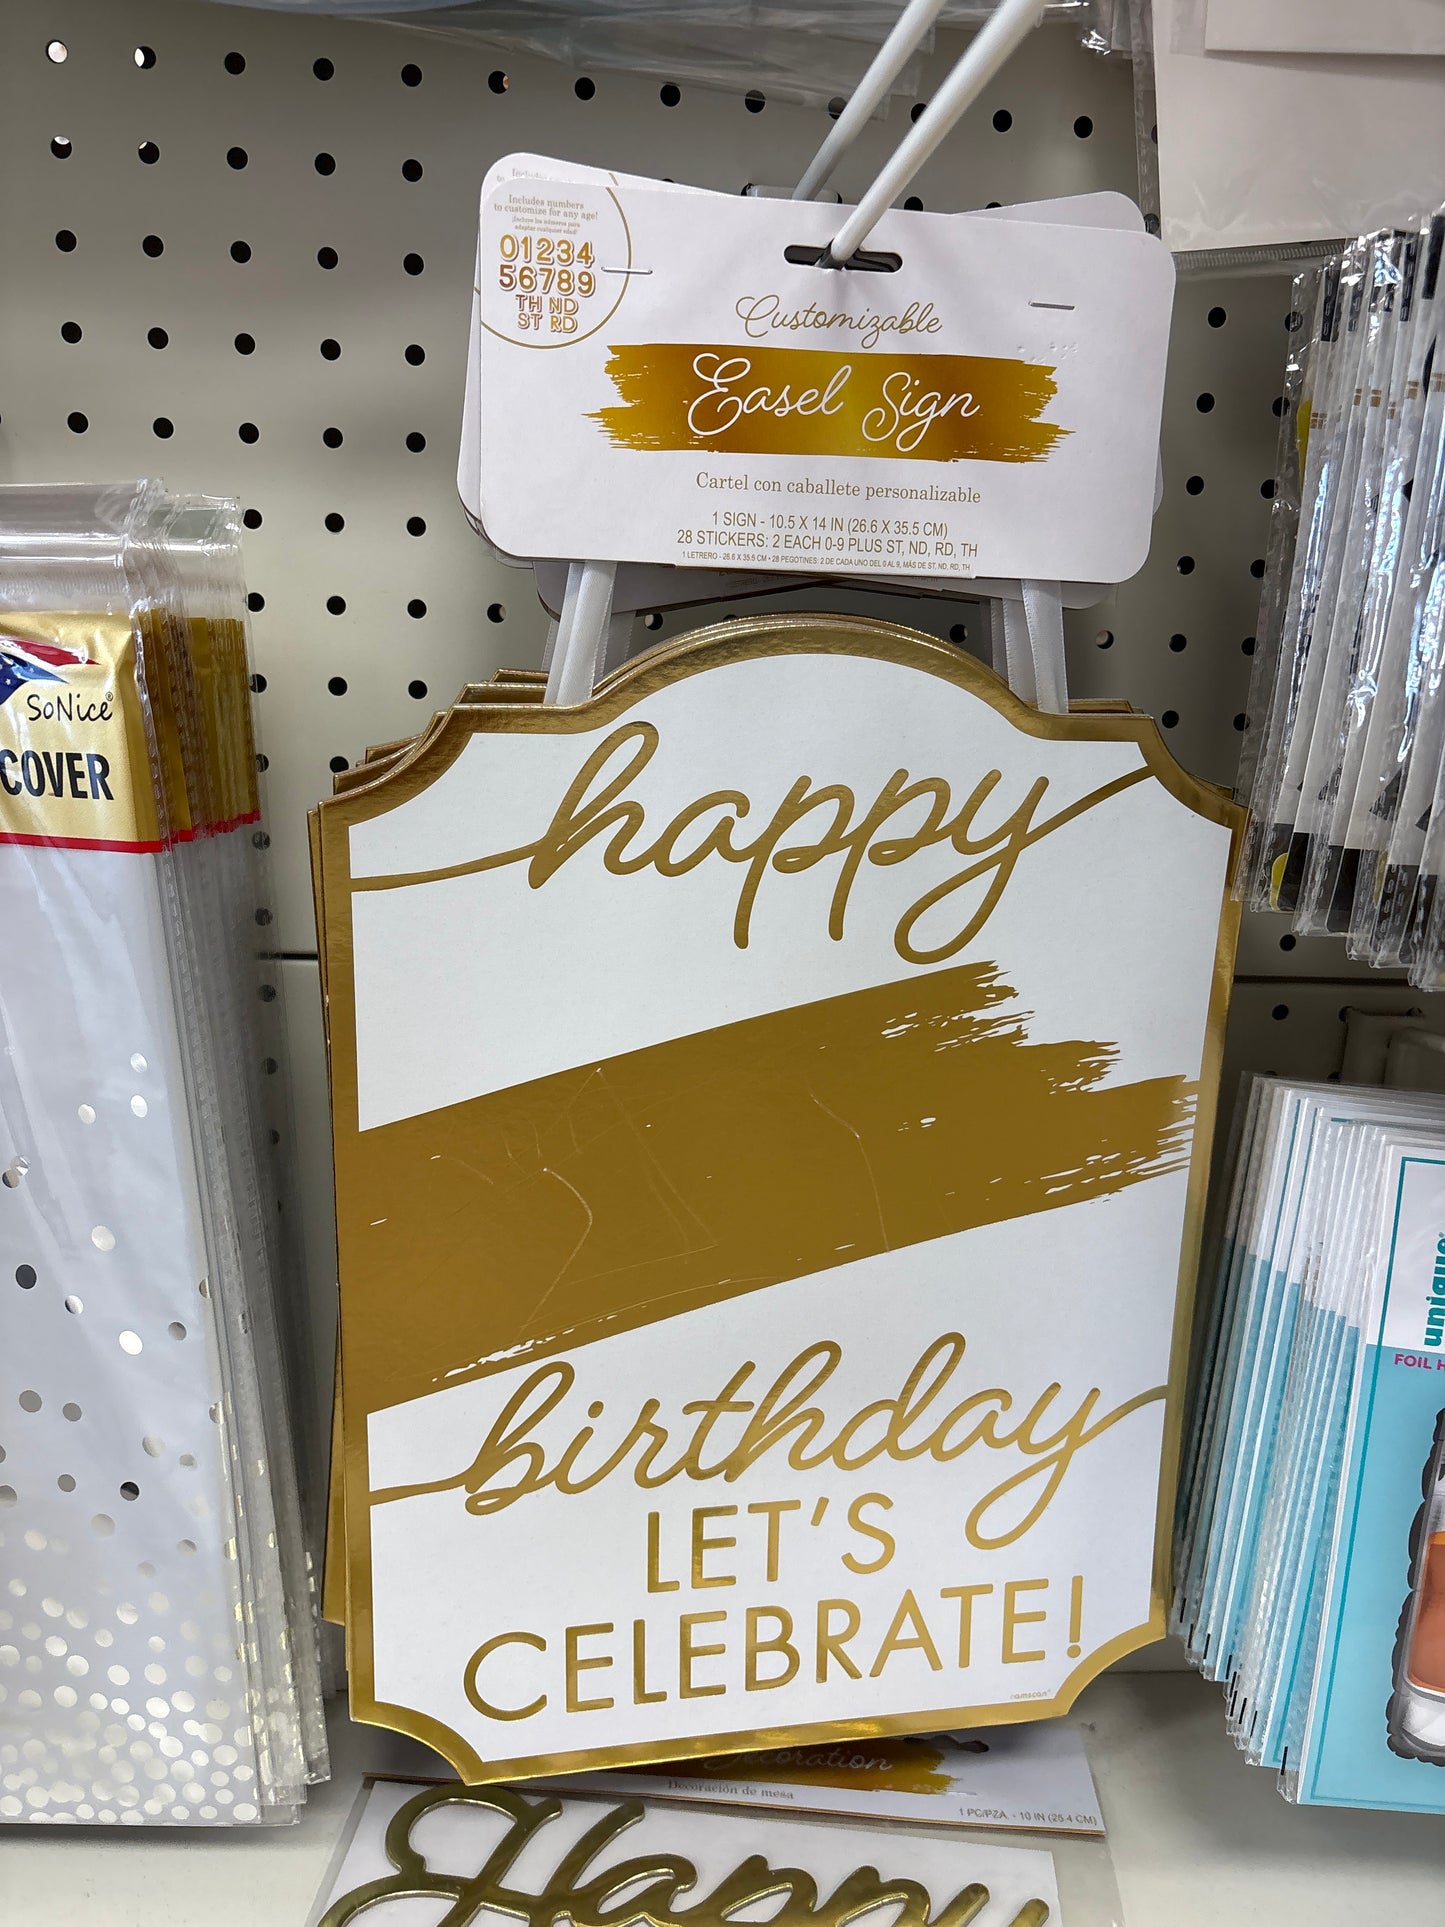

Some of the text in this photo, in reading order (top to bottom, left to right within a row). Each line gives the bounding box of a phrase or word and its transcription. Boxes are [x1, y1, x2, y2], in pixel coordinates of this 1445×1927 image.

[494, 203, 598, 222] to customize for any age!
[509, 194, 584, 209] Includes numbers
[499, 234, 595, 268] 01234
[499, 264, 596, 298] 56789
[515, 294, 579, 315] TH ND
[517, 312, 578, 333] ST RD
[735, 294, 943, 349] Customizable
[687, 352, 981, 452] Easel Sign
[696, 471, 981, 504] Cartel con caballete personalizable
[712, 511, 718, 526] 1
[723, 511, 757, 528] SIGN
[769, 513, 796, 530] 10.5
[798, 515, 808, 530] X
[812, 517, 827, 531] 14
[831, 517, 844, 532] IN
[847, 518, 878, 535] (26.6
[881, 520, 891, 534] X
[894, 521, 920, 536] 35.5
[923, 522, 948, 540] CM)
[677, 529, 978, 559] 28 STICKERS: 2 EACH 0-9 PLUS ST, ND, RD, TH
[687, 551, 718, 560] LETRERO
[722, 552, 736, 560] 26.6
[742, 554, 756, 562] 35.5
[756, 554, 767, 562] CM
[780, 555, 818, 565] PEGOTINES:
[836, 558, 853, 566] CADA
[854, 559, 868, 567] UNO
[869, 560, 882, 568] DEL
[902, 560, 917, 569] MÁS
[962, 563, 970, 571] TH
[0, 748, 114, 800] COVER
[526, 719, 1100, 965] happy
[1394, 1353, 1433, 1370] FOIL
[458, 1330, 1140, 1552] birthday
[645, 1492, 897, 1595] LET'S
[462, 1574, 1086, 1723] CELEBRATE!
[667, 1779, 794, 1800] Decoración de mesa
[1020, 1811, 1032, 1821] 10
[1033, 1812, 1045, 1822] IN
[1075, 1815, 1098, 1826] CM)
